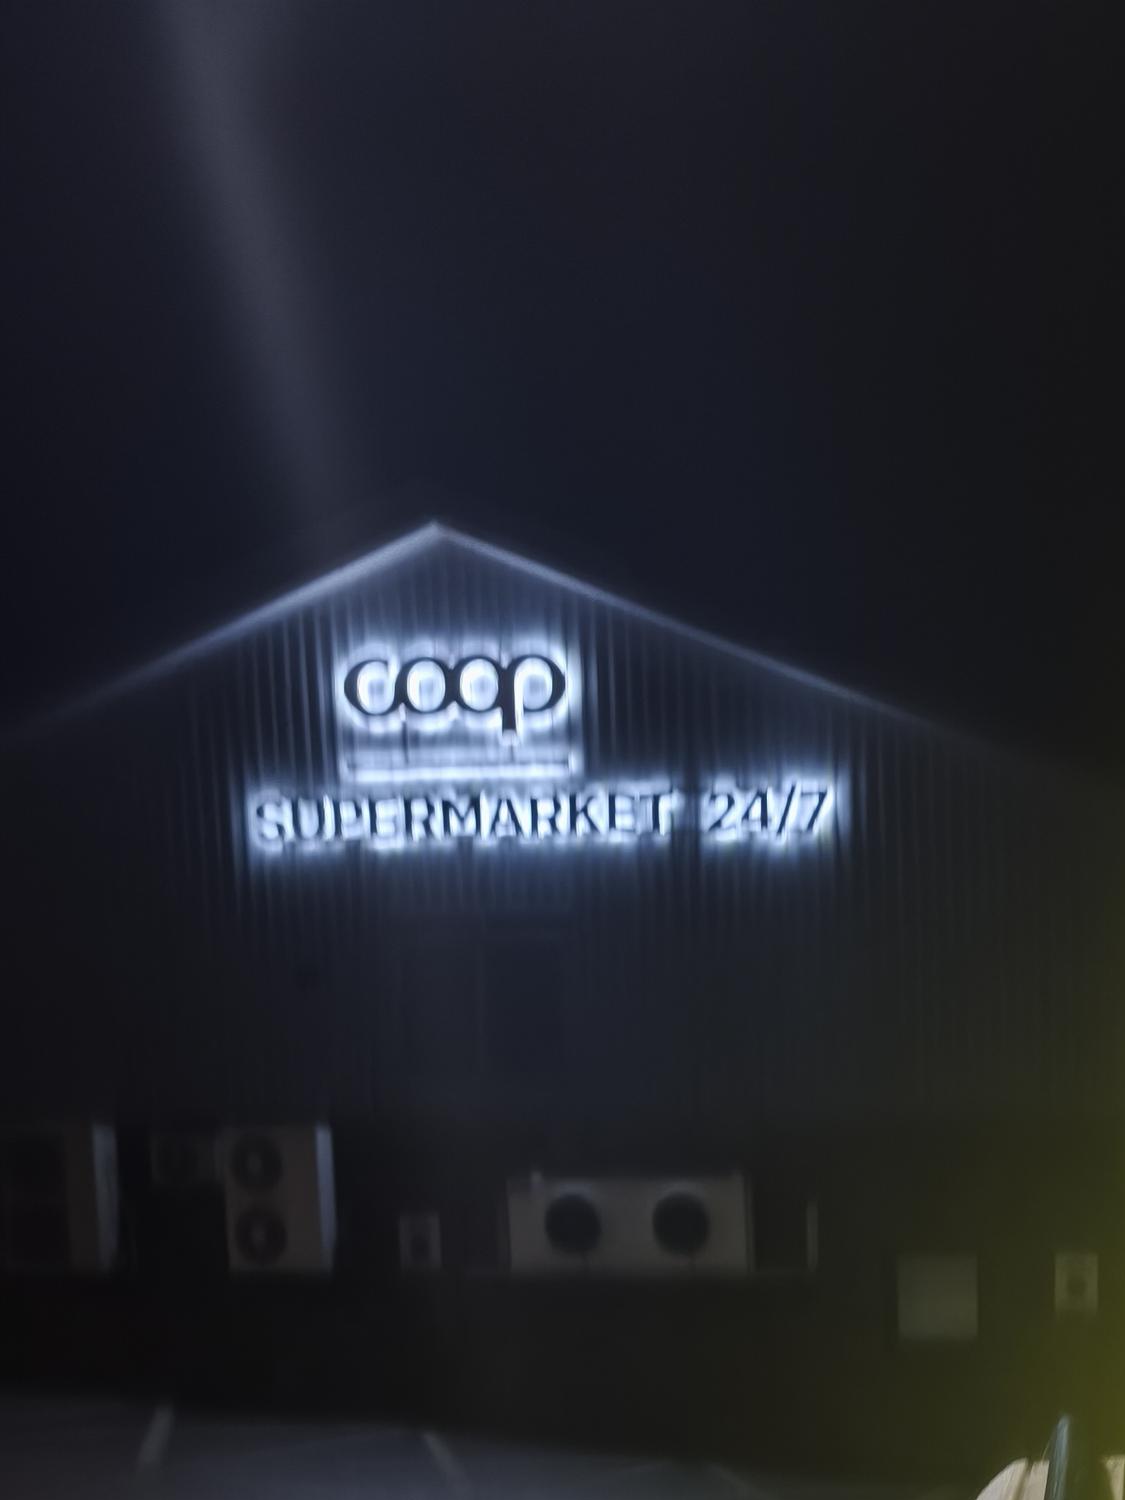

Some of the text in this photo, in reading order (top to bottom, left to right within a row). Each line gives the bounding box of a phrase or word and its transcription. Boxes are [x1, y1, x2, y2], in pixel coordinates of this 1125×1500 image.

[344, 654, 566, 732] coop
[255, 782, 835, 839] SUPERMARKET 24/7
